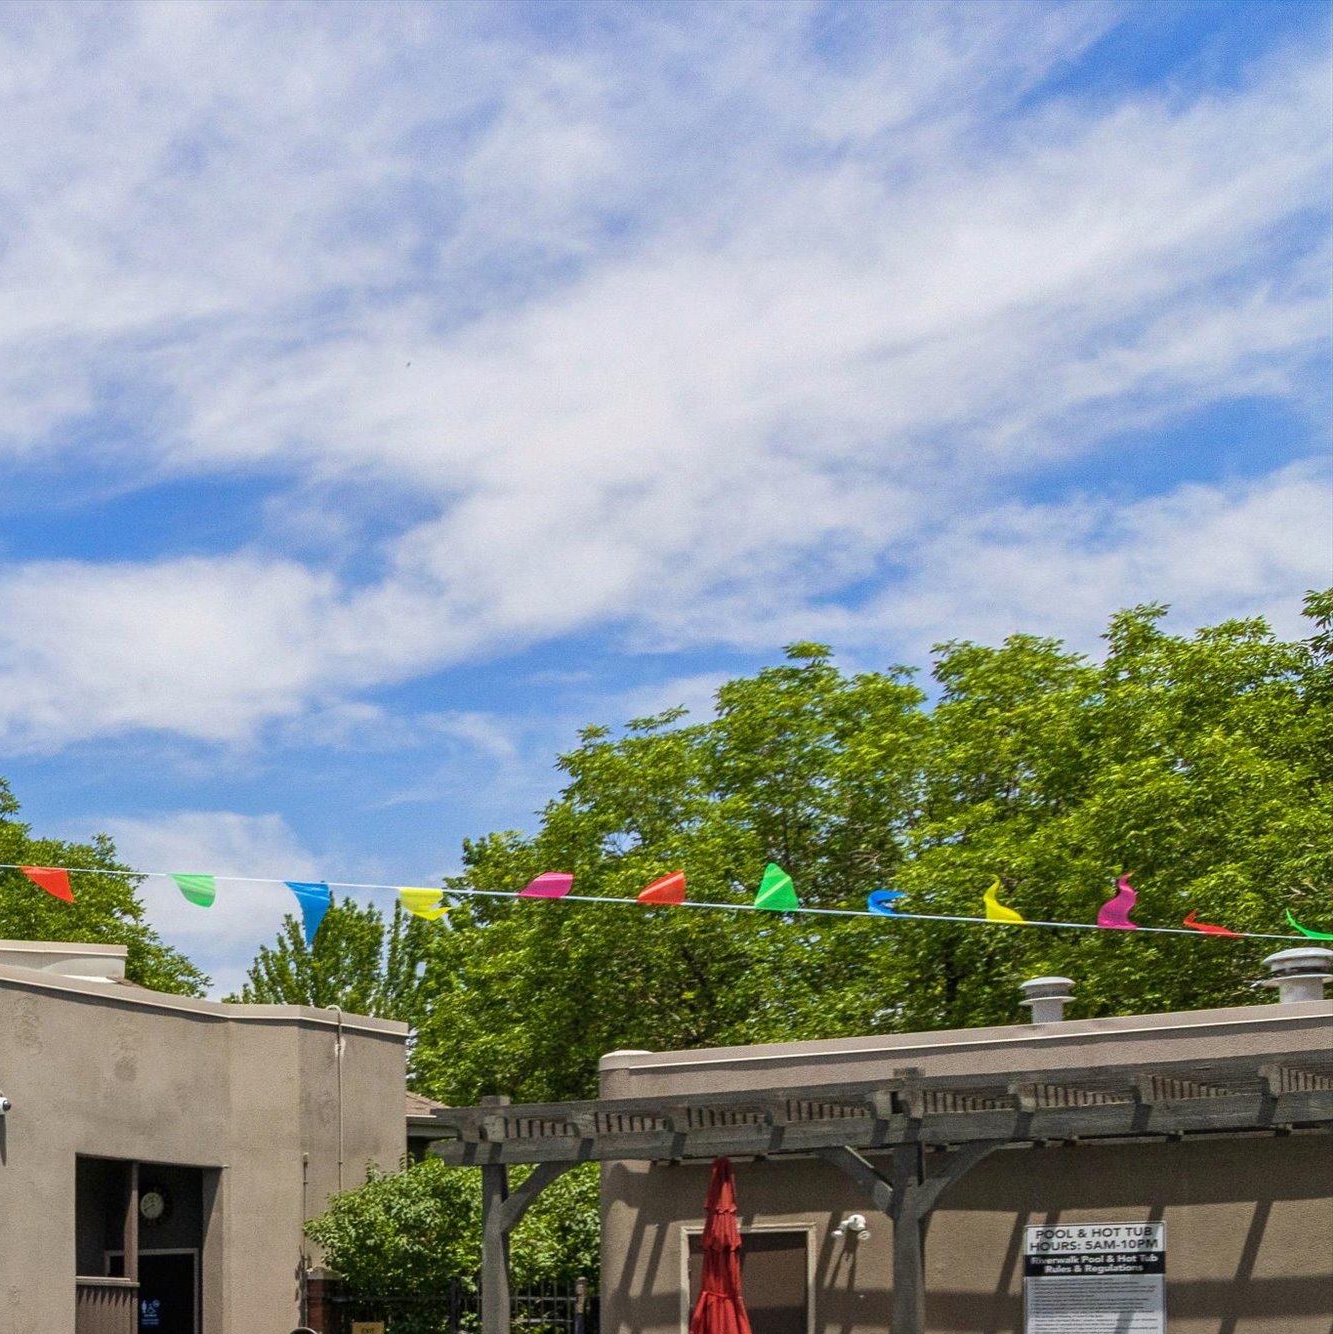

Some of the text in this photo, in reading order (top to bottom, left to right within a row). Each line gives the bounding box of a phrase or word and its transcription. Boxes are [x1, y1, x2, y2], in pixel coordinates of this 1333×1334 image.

[1036, 1226, 1153, 1239] POOL & HOT TUB
[1030, 1239, 1158, 1251] HOURS: 5AM-10PM
[1031, 1254, 1159, 1264] Riverwalk Pool & Hot Tub
[1044, 1264, 1144, 1274] Rules & Regulations
